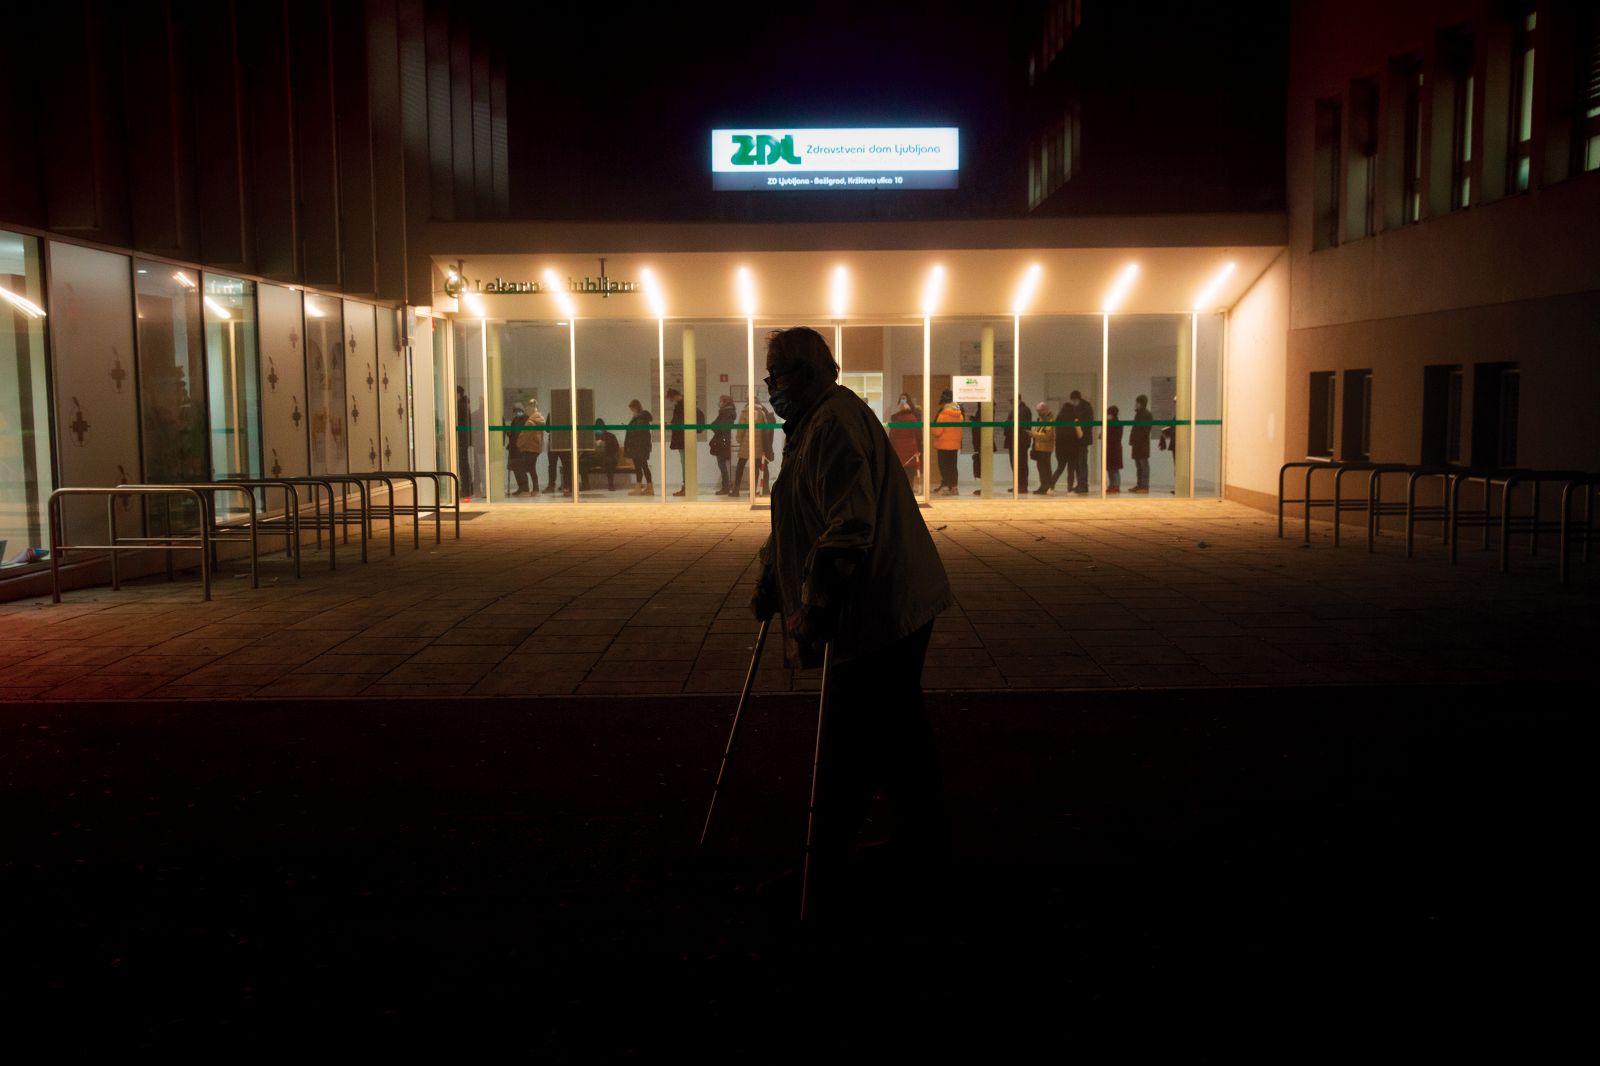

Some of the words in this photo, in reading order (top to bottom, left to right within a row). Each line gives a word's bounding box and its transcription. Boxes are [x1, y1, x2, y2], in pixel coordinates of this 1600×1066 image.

[731, 134, 801, 166] ZDL
[806, 144, 865, 154] Zdravstveni
[868, 144, 891, 154] dom
[894, 143, 941, 156] Ljubljana
[767, 177, 777, 185] ZD
[778, 177, 809, 187] Ljubljana
[895, 176, 904, 184] 10
